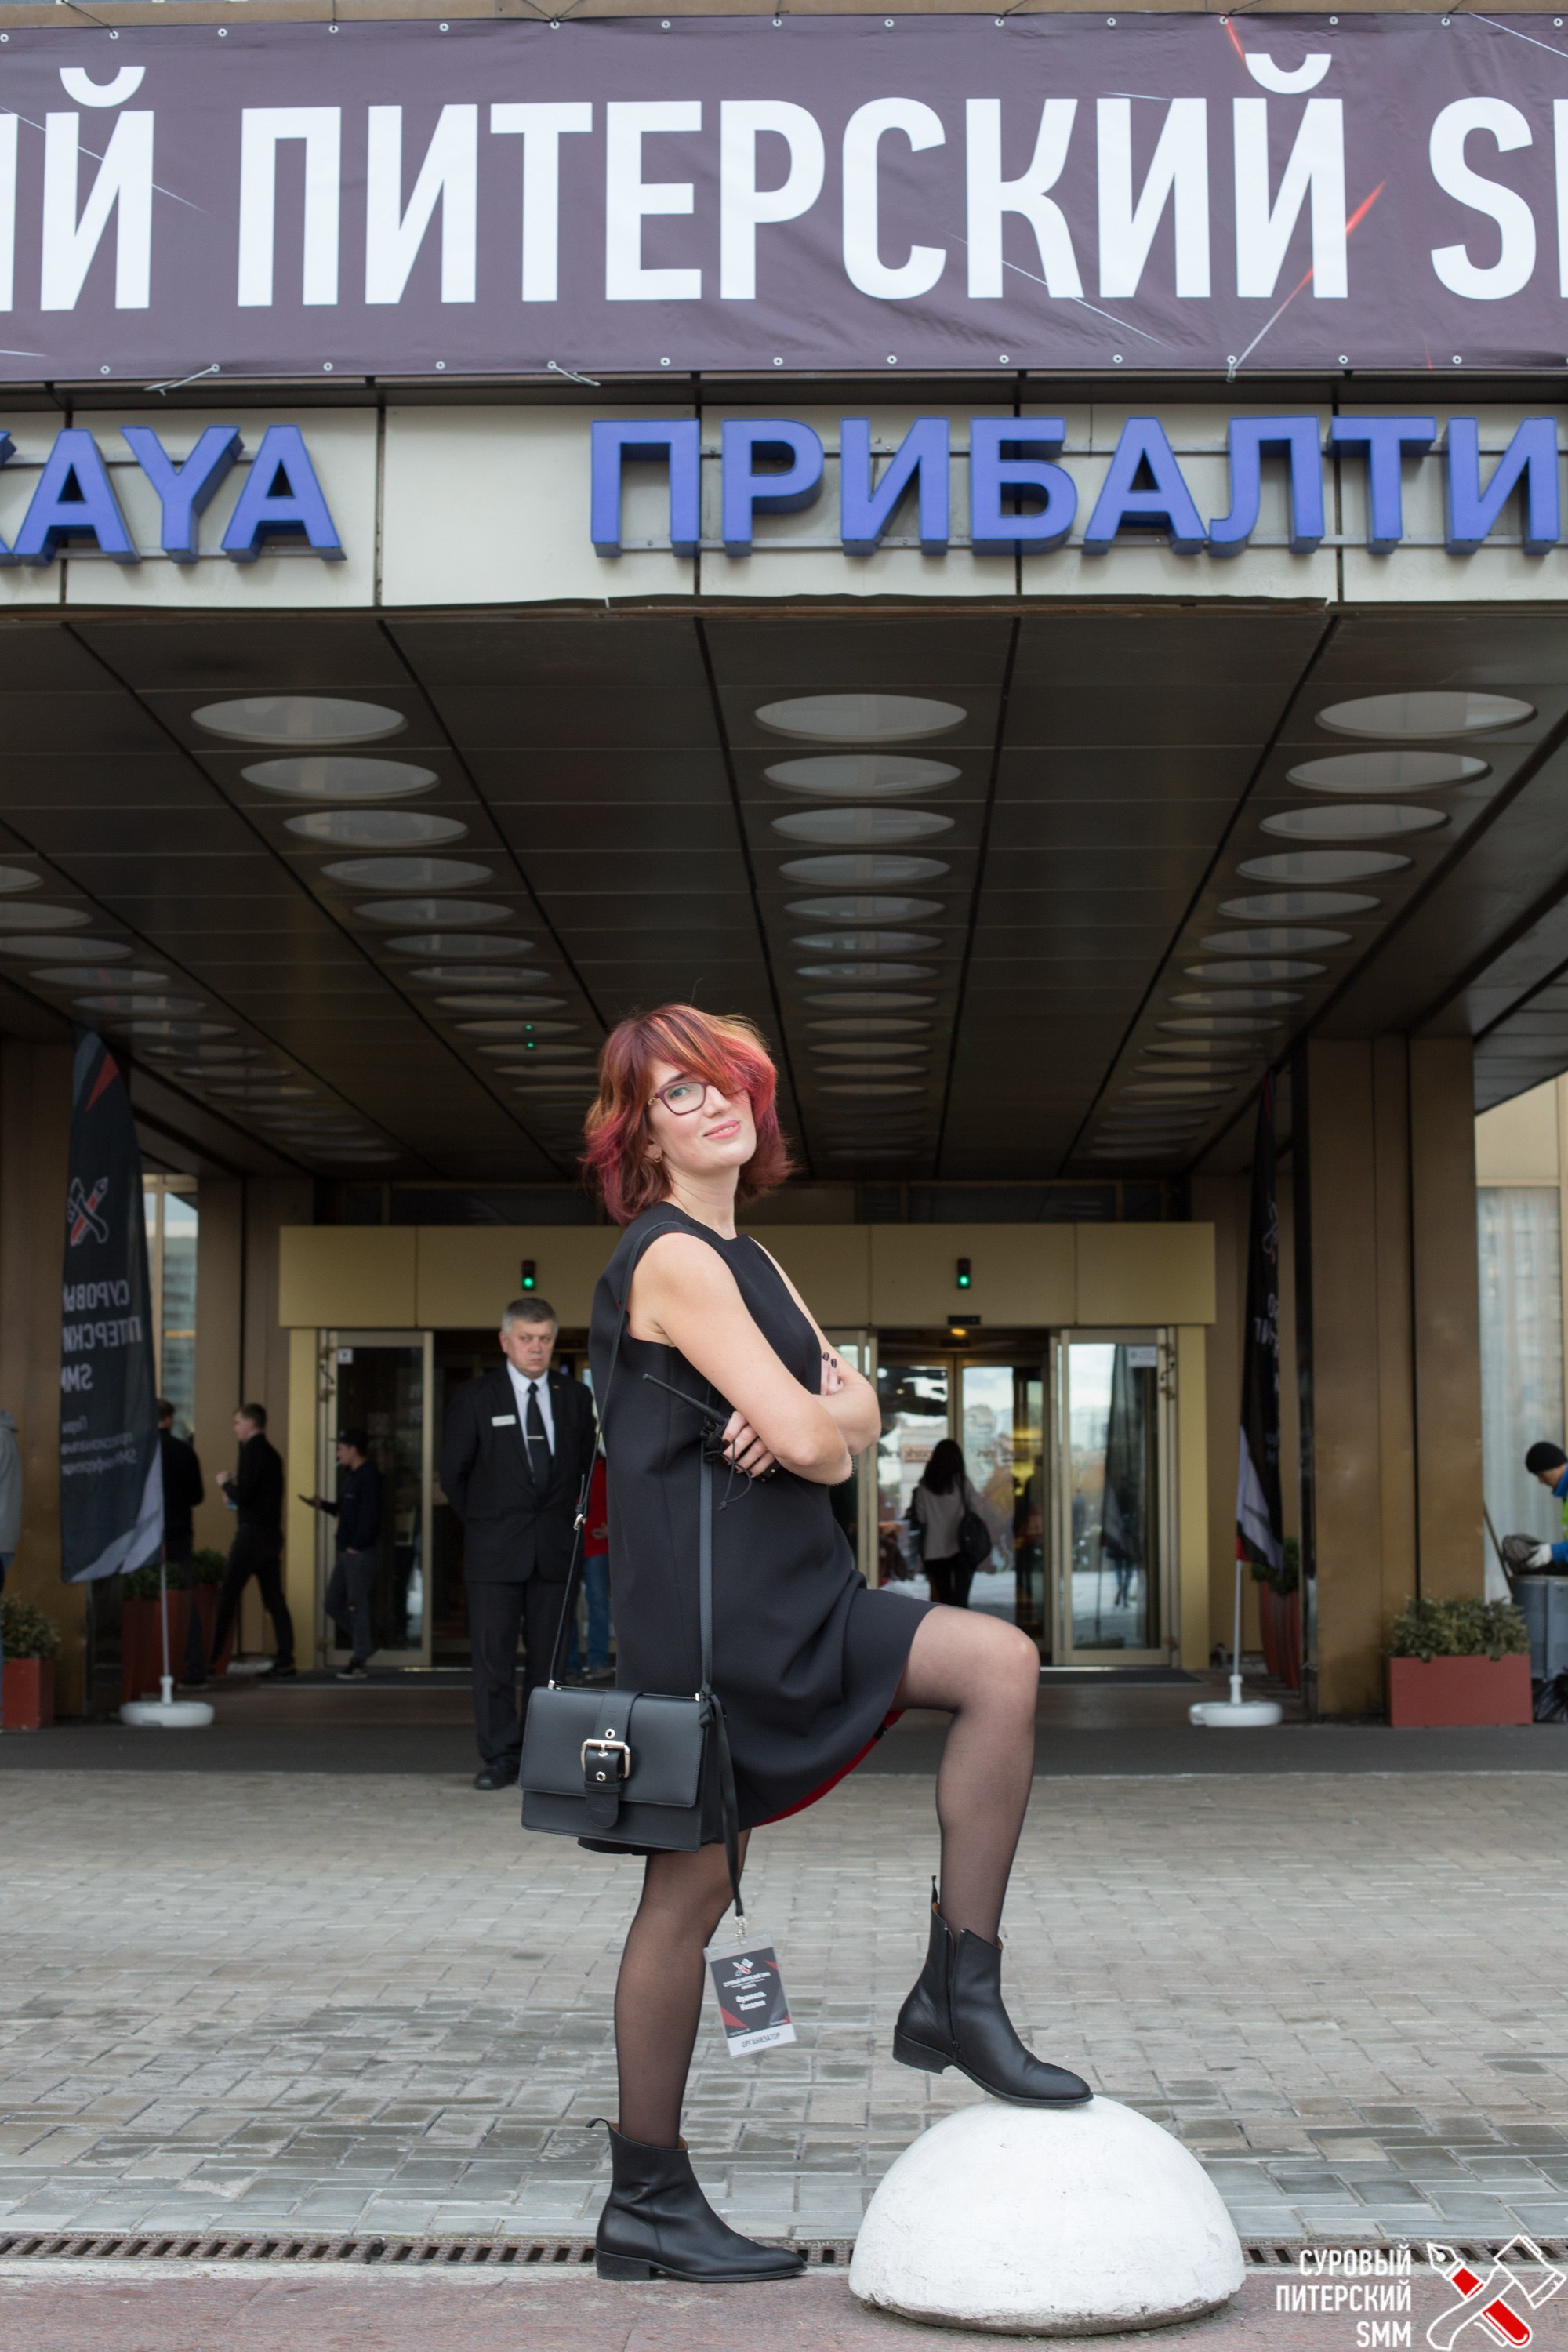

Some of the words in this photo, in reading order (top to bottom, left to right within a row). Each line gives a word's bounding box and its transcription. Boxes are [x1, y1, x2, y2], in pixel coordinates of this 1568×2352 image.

[0, 66, 154, 311] Й
[238, 53, 1348, 307] ПИТЕРСКИЙ
[1428, 96, 1568, 299] S
[0, 424, 347, 564] AYA
[590, 415, 1561, 558] ПРИБАЛТИ
